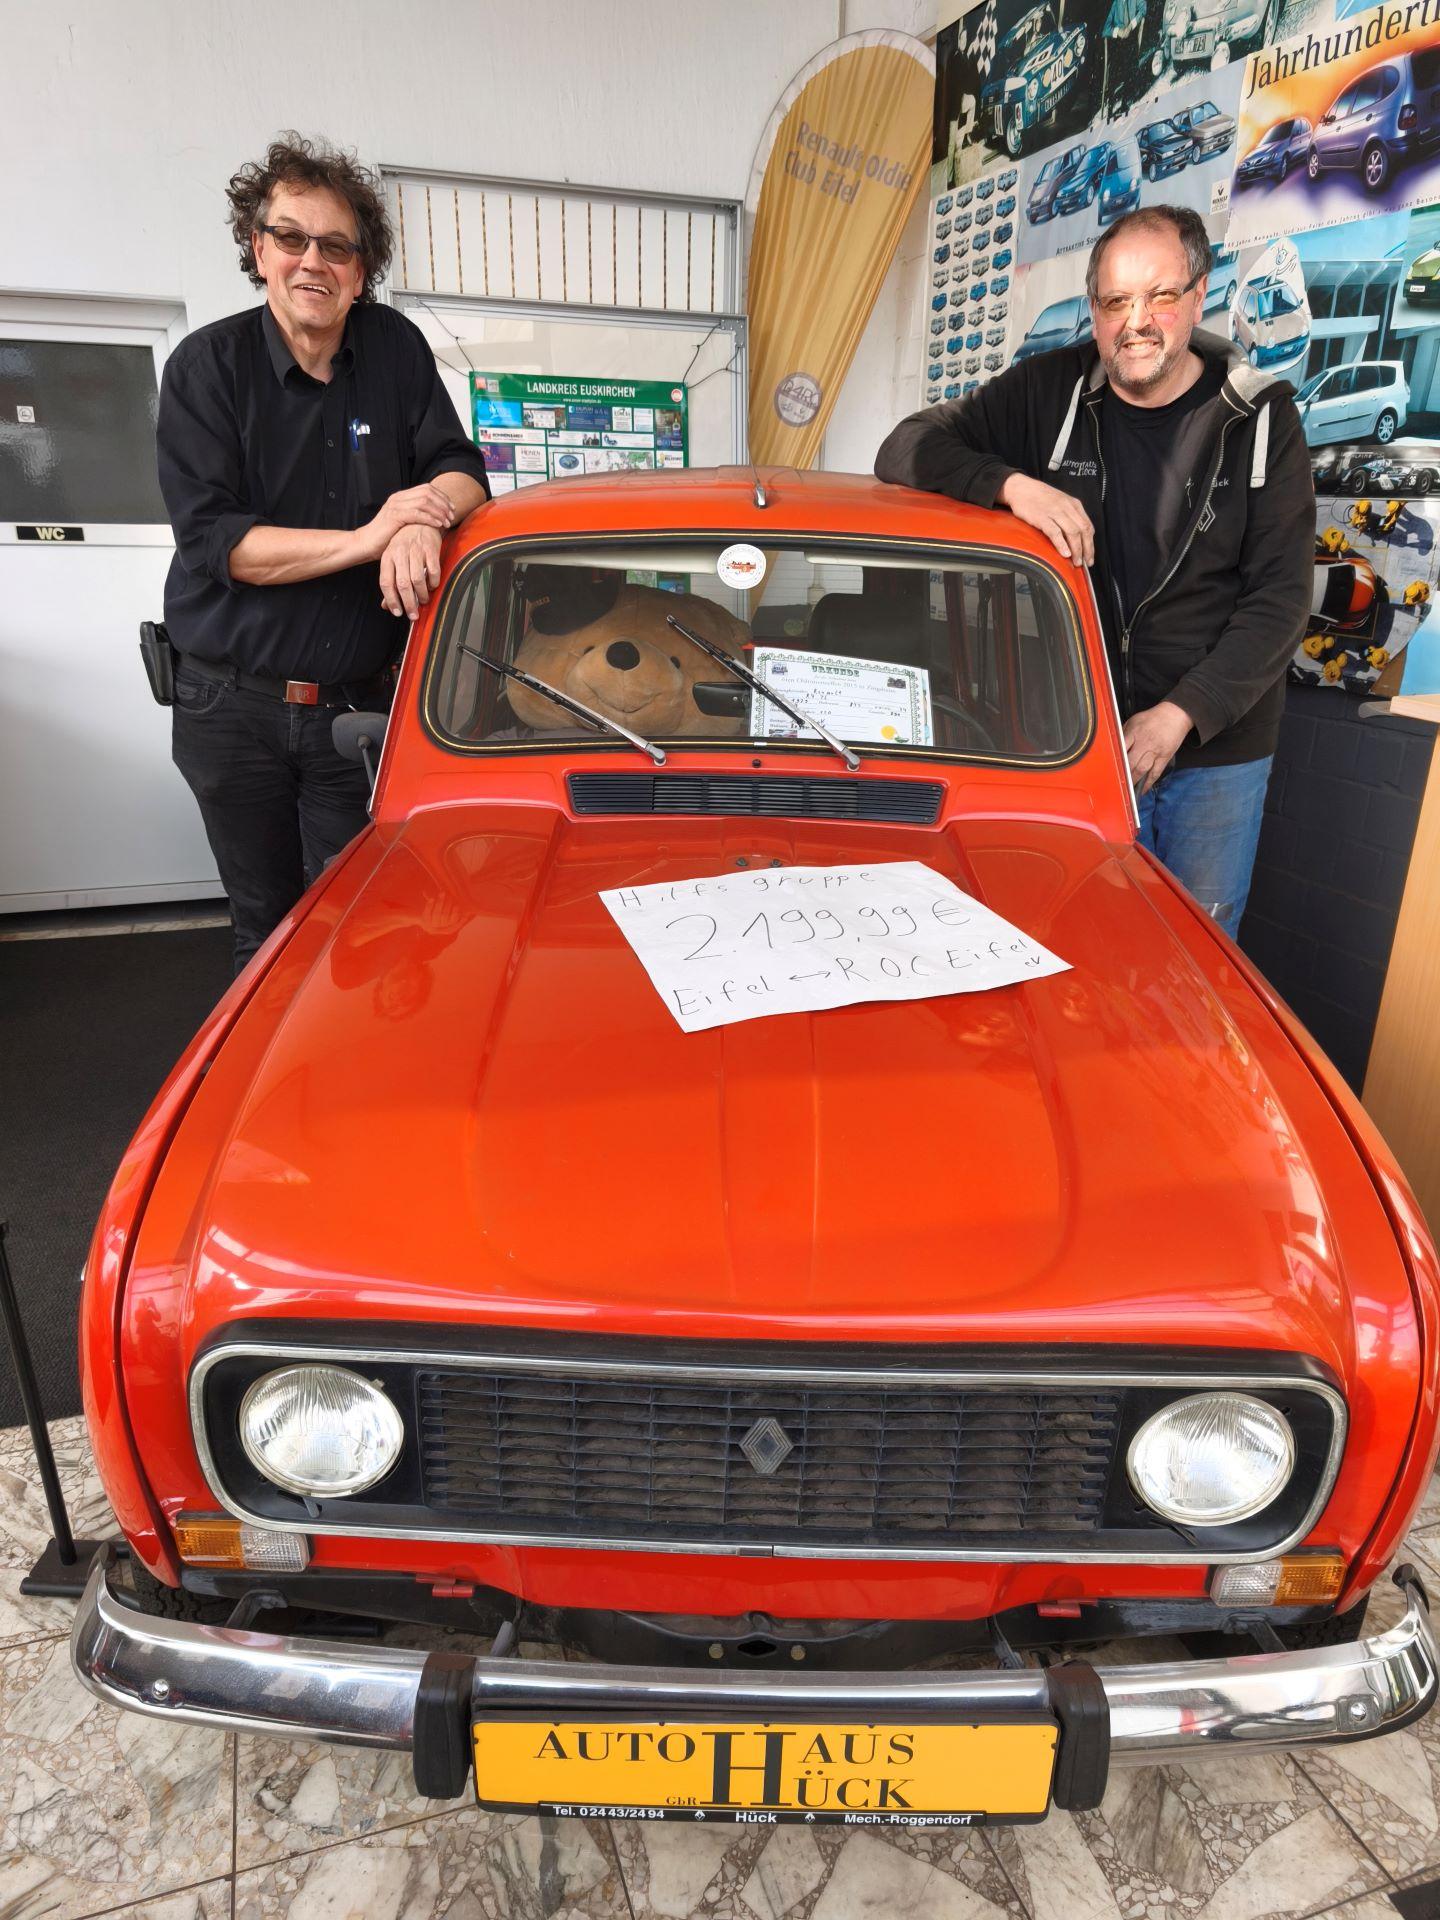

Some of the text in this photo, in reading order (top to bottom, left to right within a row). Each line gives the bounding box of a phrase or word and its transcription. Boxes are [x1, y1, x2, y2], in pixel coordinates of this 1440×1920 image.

[796, 121, 912, 192] Renault Oldie
[784, 151, 861, 205] Club Eifel
[527, 381, 636, 398] LANDKREIS EUSKIRCHEN
[35, 527, 65, 541] WC
[811, 665, 860, 677] URKUNDE
[672, 975, 775, 1015] Eifel
[946, 939, 1028, 969] Eifel
[666, 1796, 697, 1806] GbR
[553, 1806, 576, 1817] Tel.
[735, 1811, 777, 1824] Hück
[844, 1814, 972, 1826] Mech.-Roggendorf
